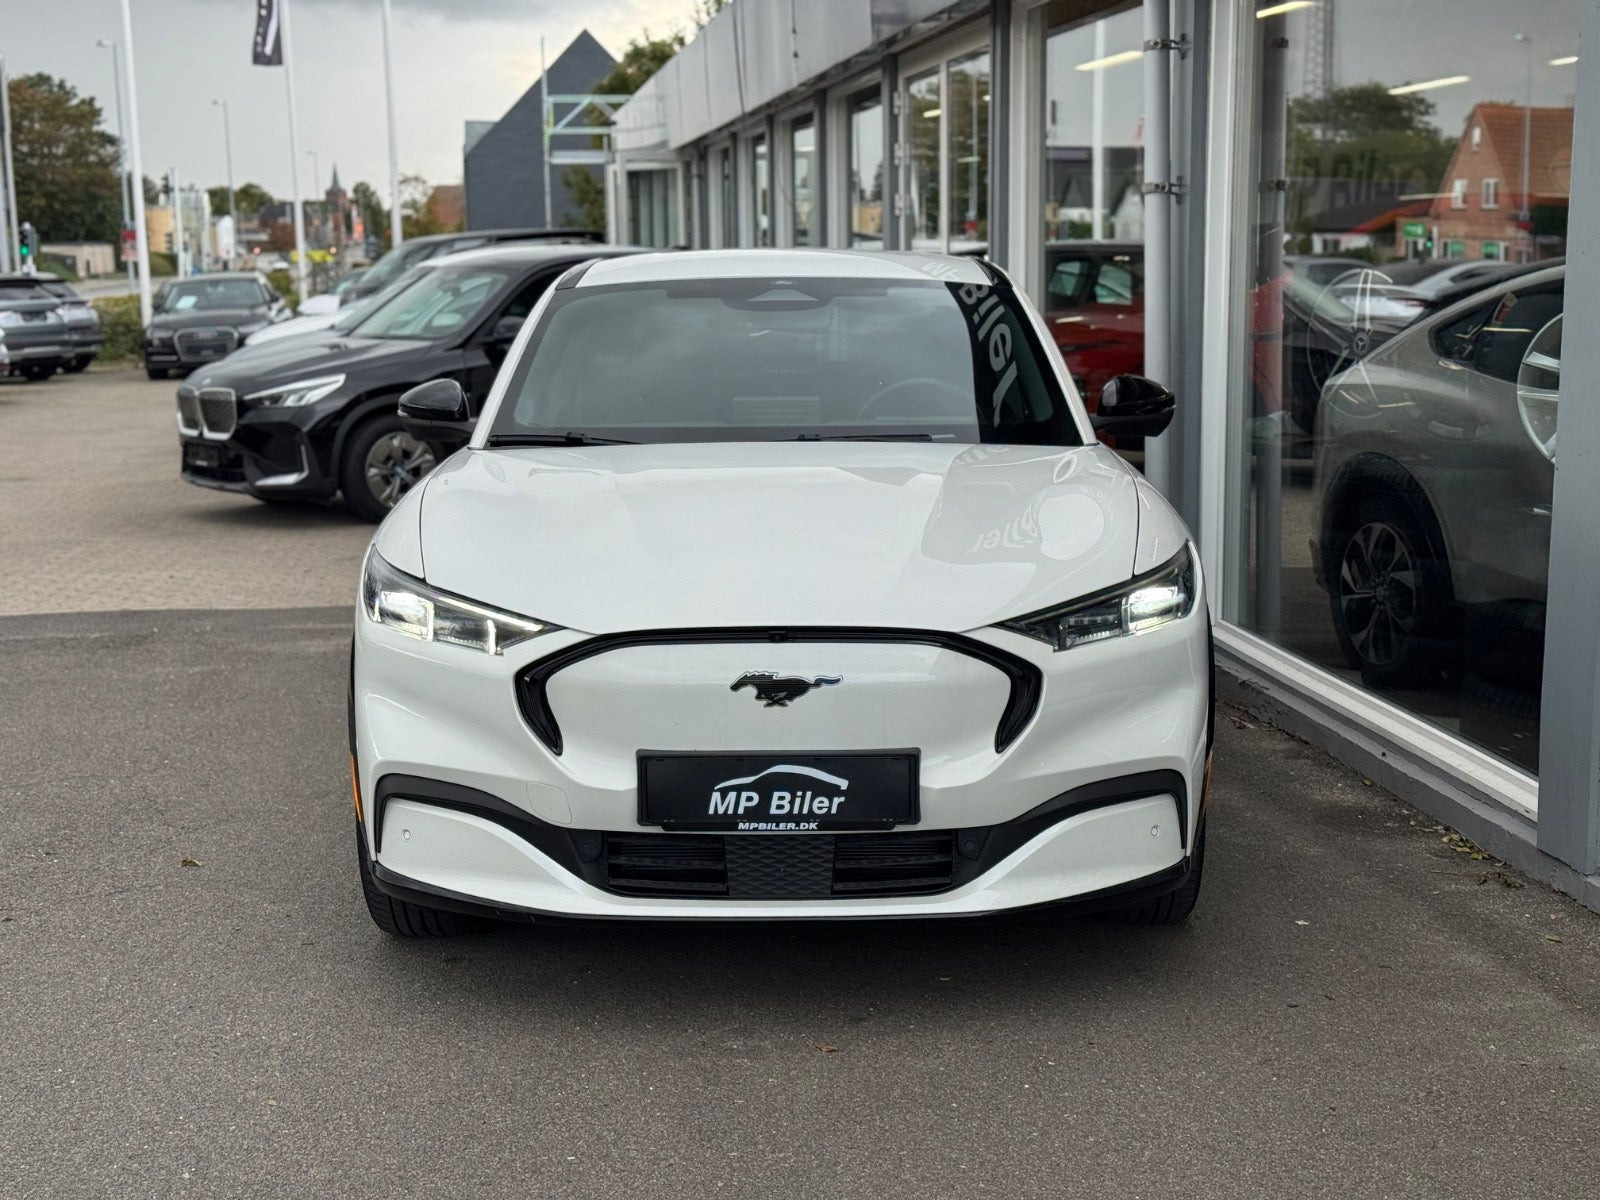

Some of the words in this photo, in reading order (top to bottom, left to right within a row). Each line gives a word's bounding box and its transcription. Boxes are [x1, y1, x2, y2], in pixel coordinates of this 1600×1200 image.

[708, 791, 760, 815] MP
[769, 791, 845, 815] Biler
[737, 822, 819, 831] MPBILER.DK
